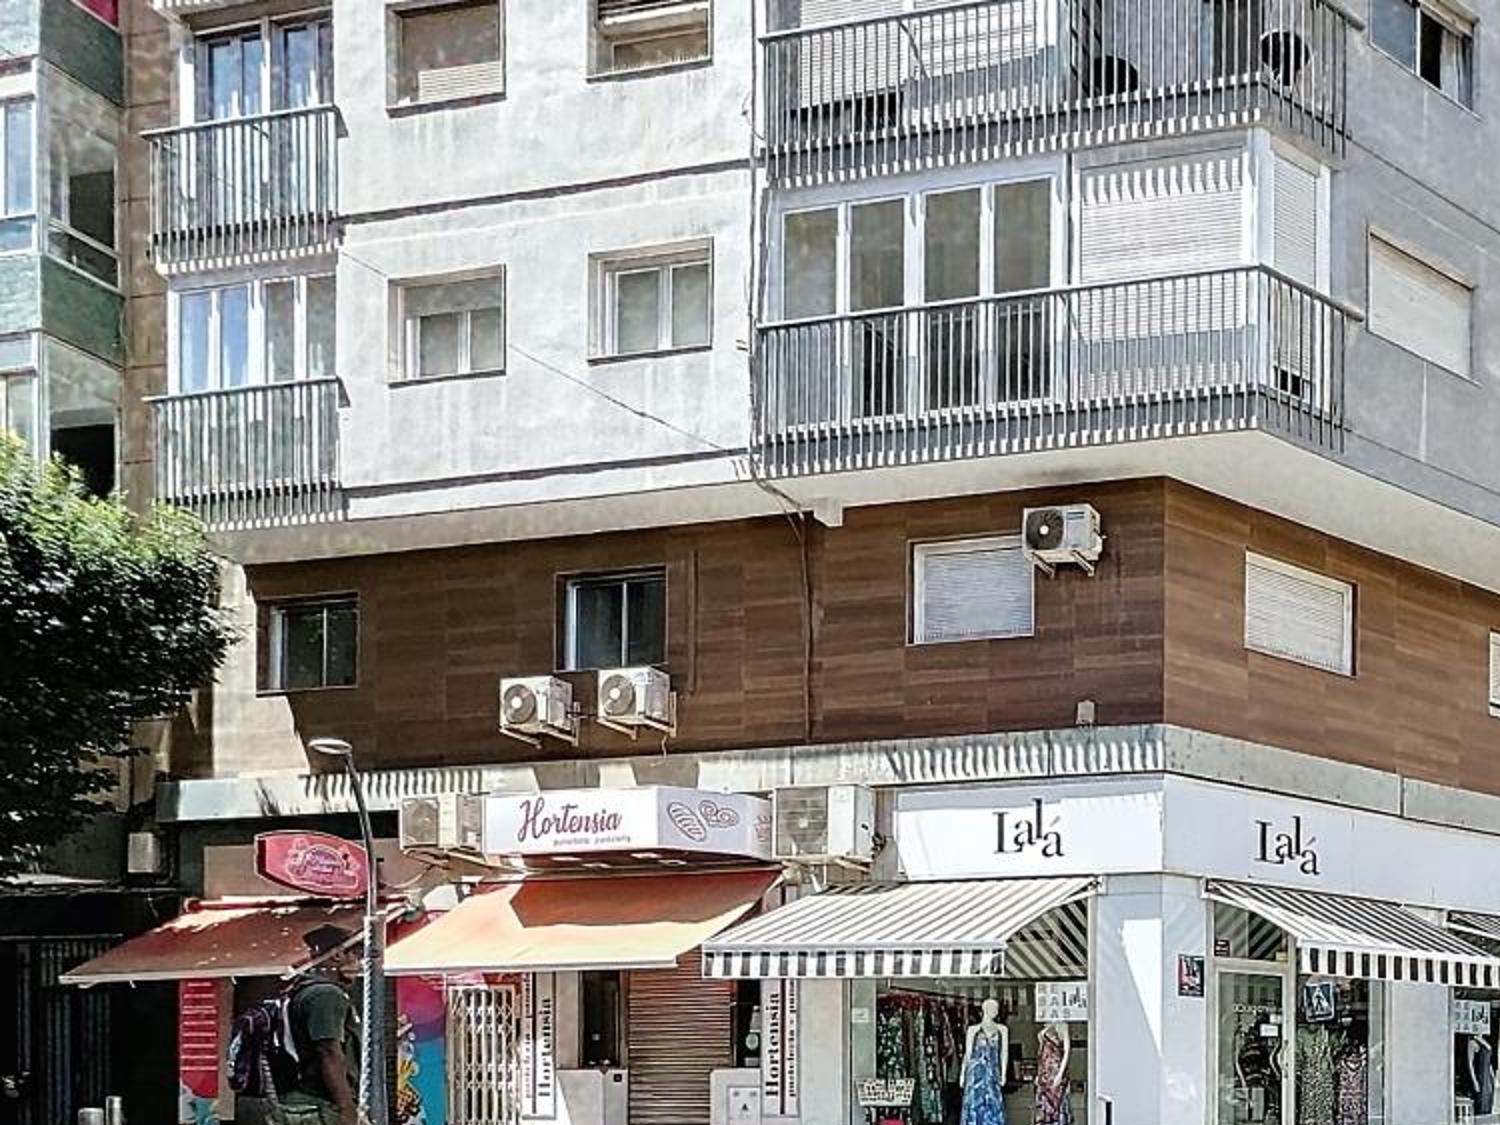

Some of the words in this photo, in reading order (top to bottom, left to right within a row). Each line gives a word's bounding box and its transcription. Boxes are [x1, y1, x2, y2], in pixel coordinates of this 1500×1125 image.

[517, 796, 623, 843] Hortensia
[992, 797, 1065, 858] Lalá
[1254, 815, 1321, 875] Lalá
[765, 993, 779, 1097] Hortensia
